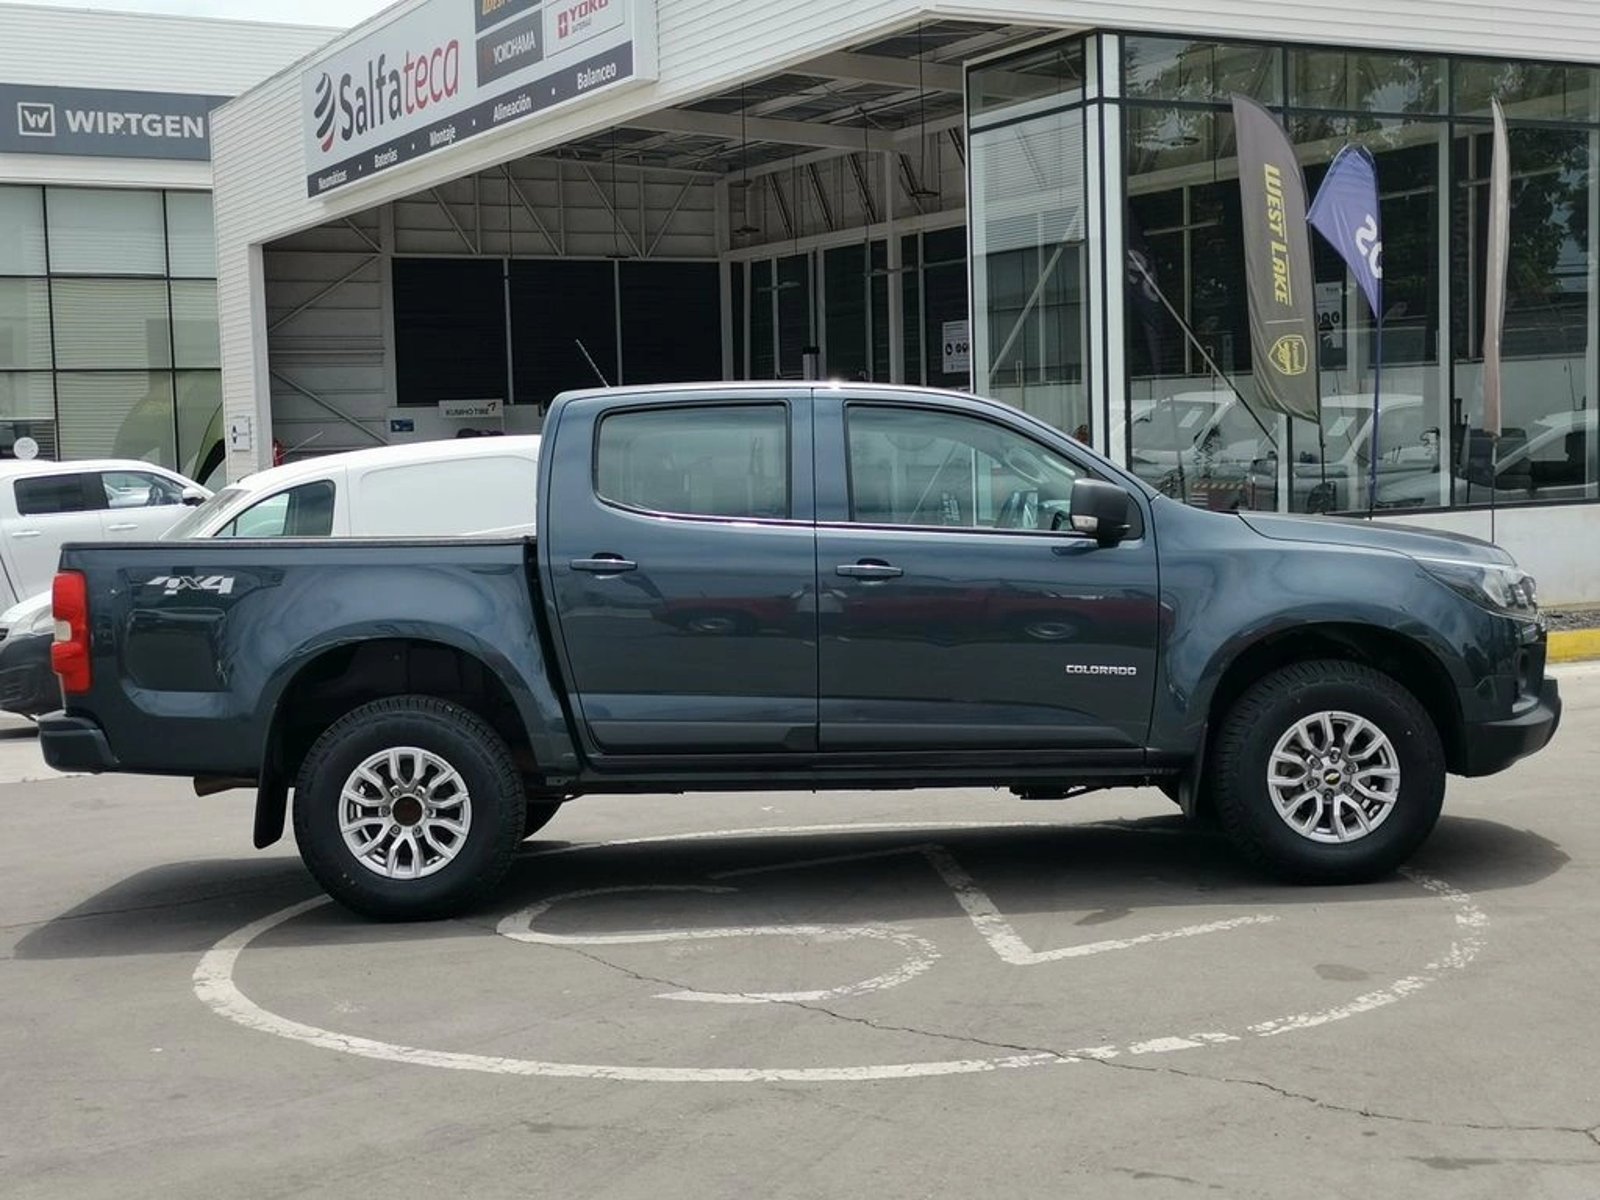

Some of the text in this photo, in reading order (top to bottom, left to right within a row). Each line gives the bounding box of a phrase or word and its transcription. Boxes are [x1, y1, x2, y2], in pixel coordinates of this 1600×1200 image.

[493, 30, 536, 65] YOKOHAMA
[339, 39, 459, 141] Salfateca
[429, 124, 456, 147] Montaje
[493, 93, 532, 123] Alineación
[577, 62, 617, 90] Balanceo
[65, 110, 205, 138] WIRTGEN
[1264, 163, 1290, 306] WEST LAKE
[1066, 664, 1137, 676] COLORADO
